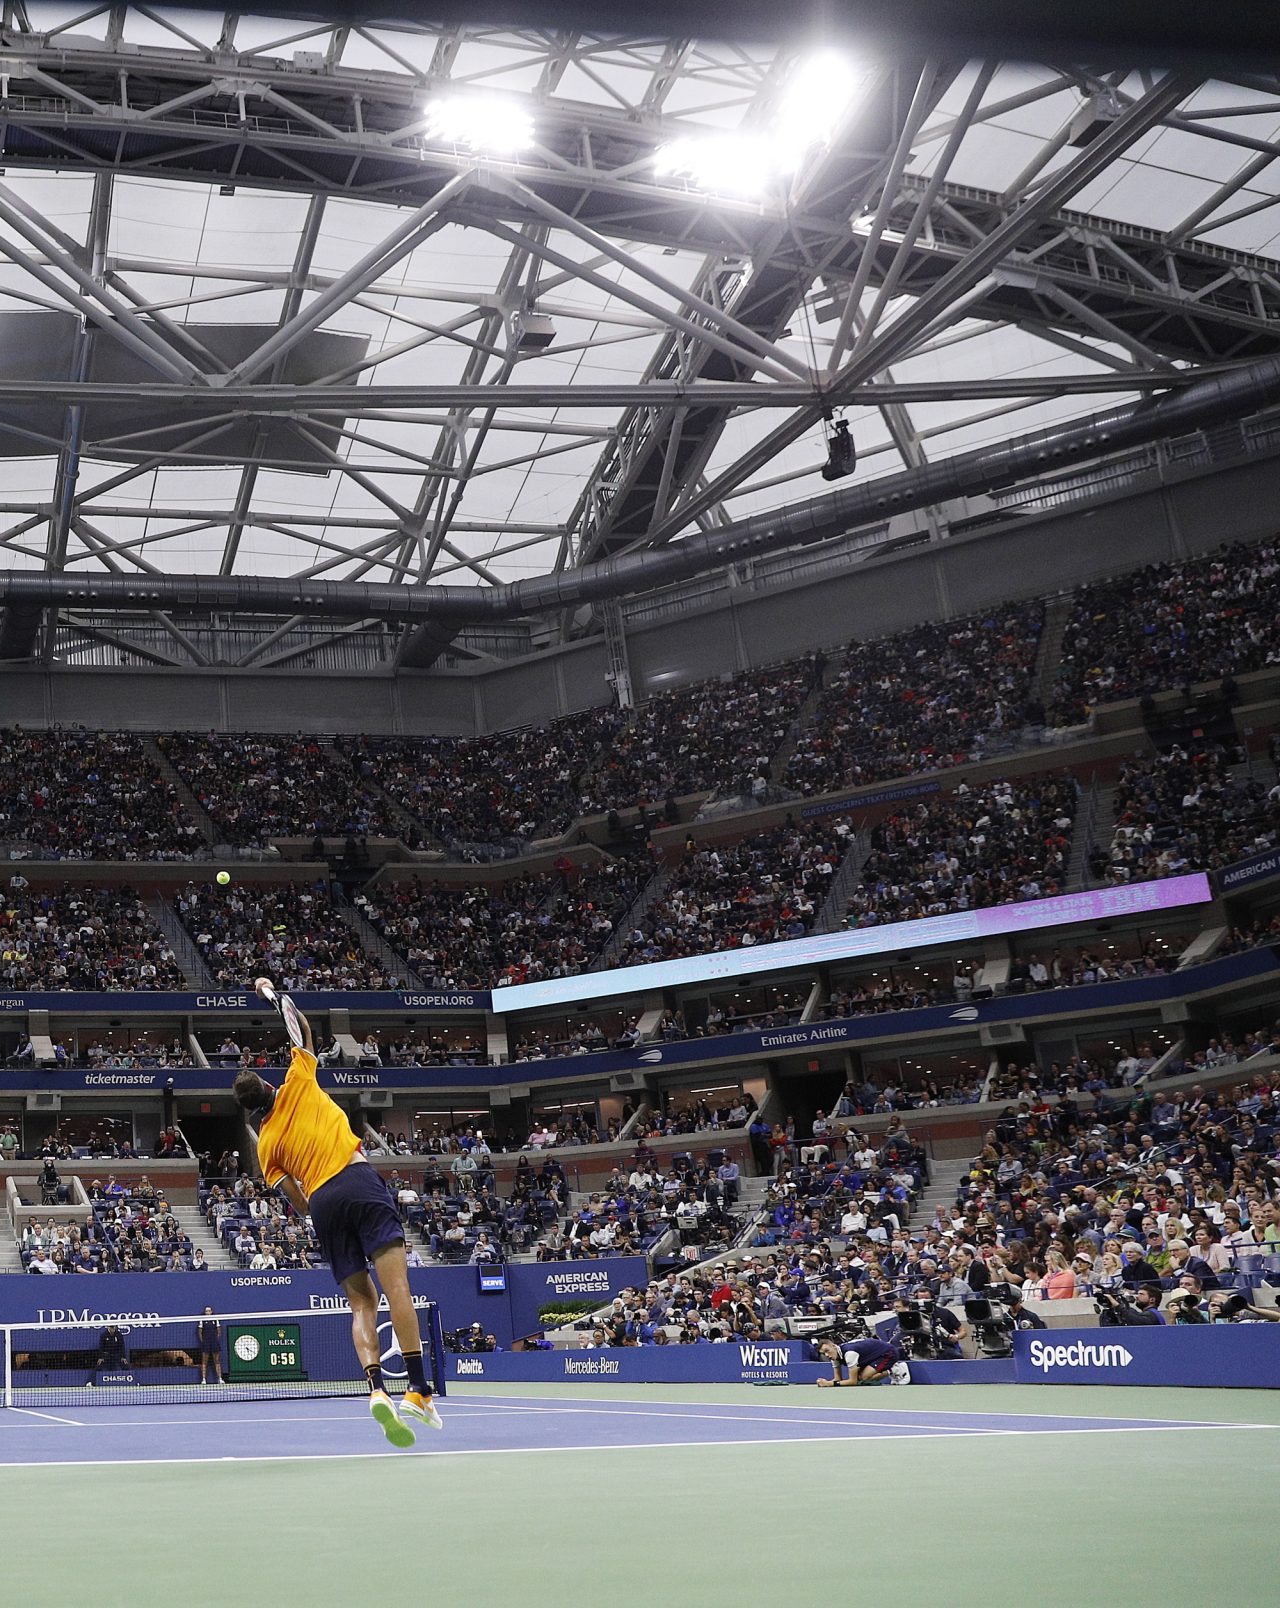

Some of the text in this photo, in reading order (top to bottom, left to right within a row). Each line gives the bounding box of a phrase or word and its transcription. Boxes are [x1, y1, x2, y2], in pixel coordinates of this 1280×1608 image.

[802, 808, 825, 817] GUEST
[866, 794, 884, 804] TEXT
[1224, 858, 1276, 884] AMERICAN
[1098, 884, 1161, 914] IBM
[196, 996, 247, 1007] CHASE
[404, 995, 474, 1006] USOPEN.ORG
[760, 1027, 848, 1047] Emirates Airline
[85, 1073, 156, 1086] ticketmaster
[230, 1276, 292, 1286] USOPEN.ORG
[546, 1272, 608, 1284] AMERICAN
[556, 1282, 610, 1294] EXPRESS
[270, 1352, 295, 1366] 0:58
[1030, 1340, 1125, 1373] Spectrum
[564, 1356, 620, 1374] Mercedes-Benz
